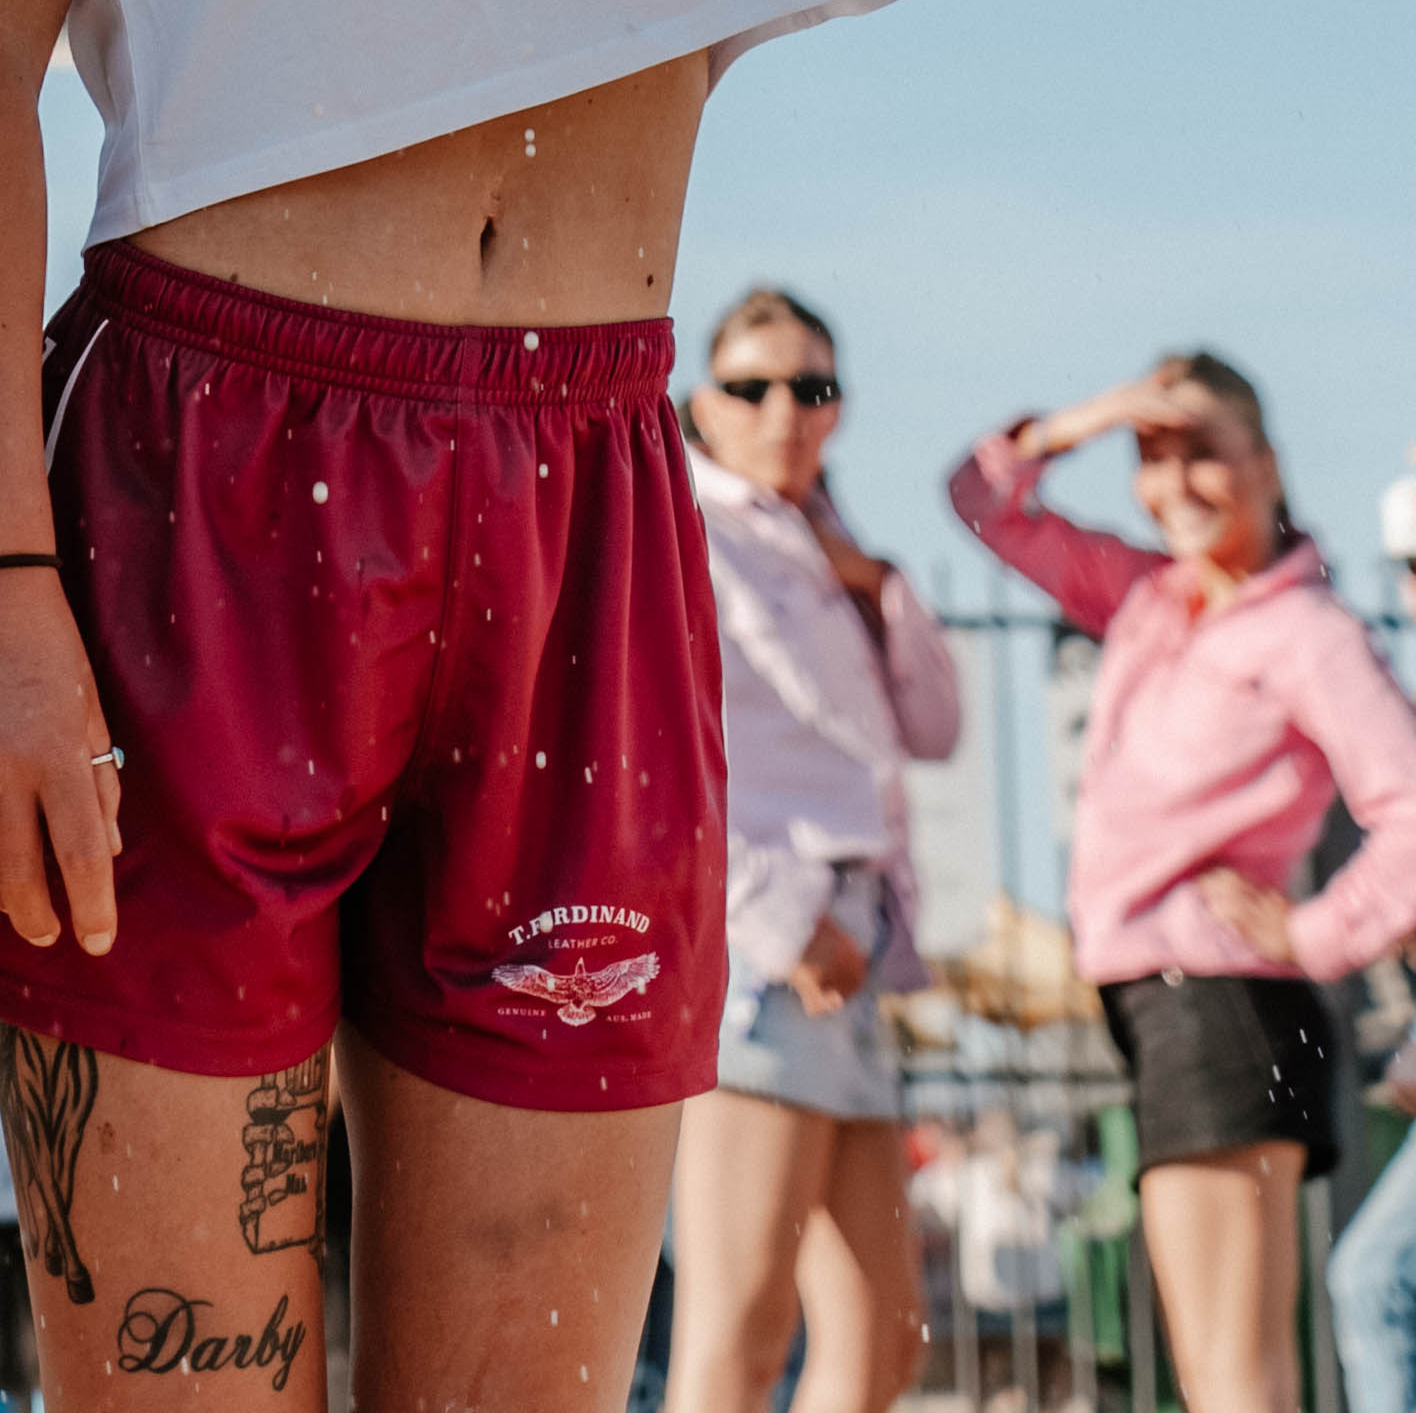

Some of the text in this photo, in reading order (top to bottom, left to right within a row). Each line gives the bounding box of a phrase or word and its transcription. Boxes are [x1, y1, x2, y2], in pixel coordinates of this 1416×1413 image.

[507, 904, 651, 946] T.FRDINAND
[547, 934, 619, 950] LEATHER CO.
[496, 1007, 547, 1018] GENUINE
[116, 1286, 307, 1393] Darby
